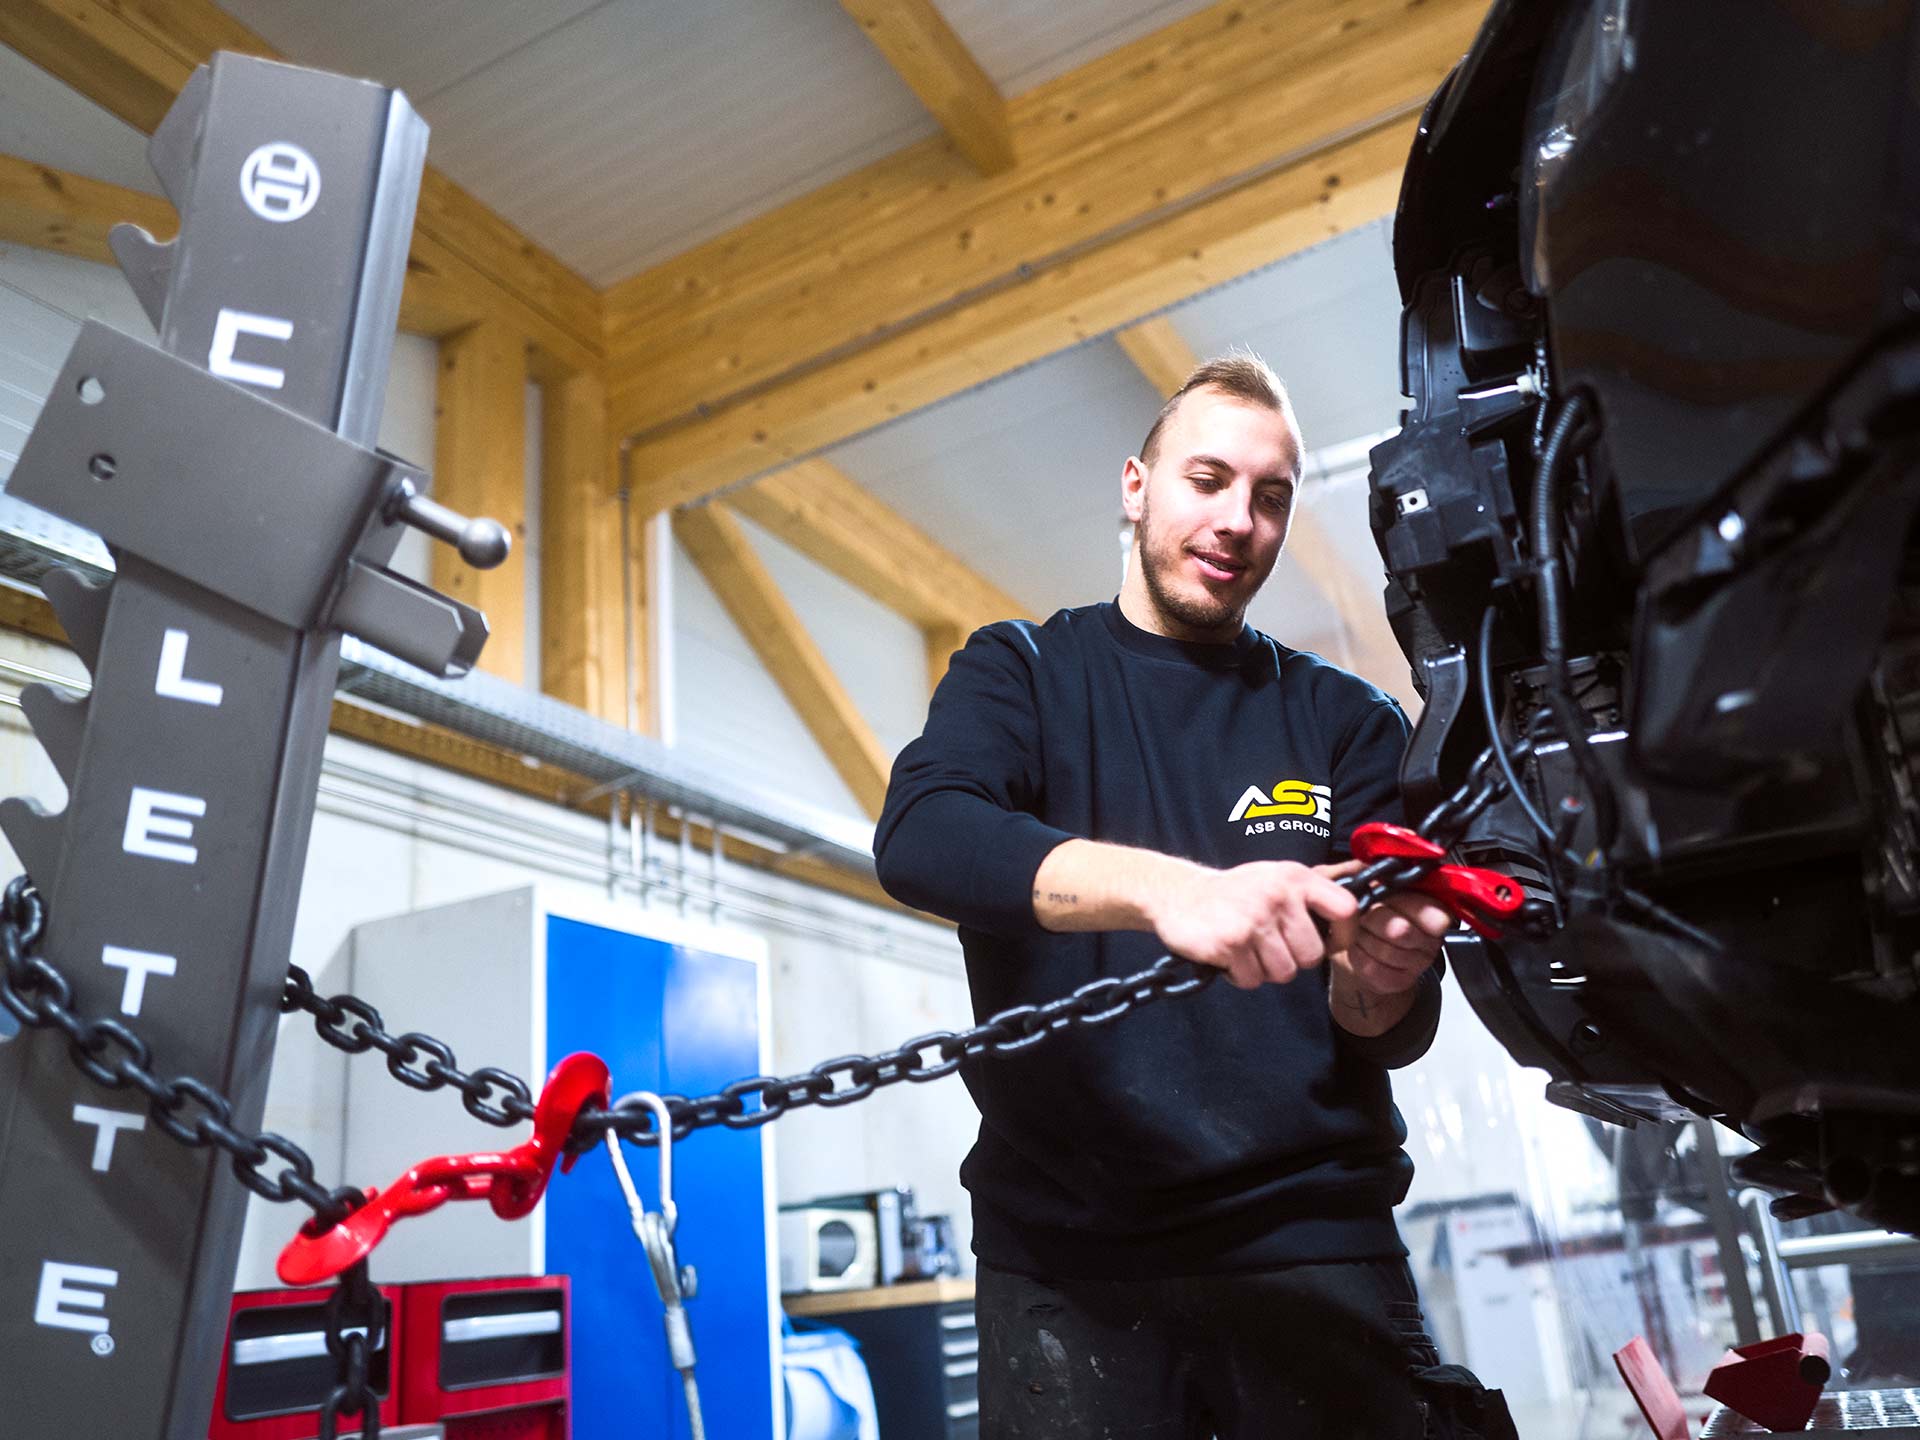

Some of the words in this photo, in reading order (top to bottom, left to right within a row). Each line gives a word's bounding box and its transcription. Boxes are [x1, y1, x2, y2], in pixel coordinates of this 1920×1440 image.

[34, 307, 295, 1334] CLETTE
[1245, 821, 1276, 836] ASB
[1279, 820, 1331, 839] GROUP
